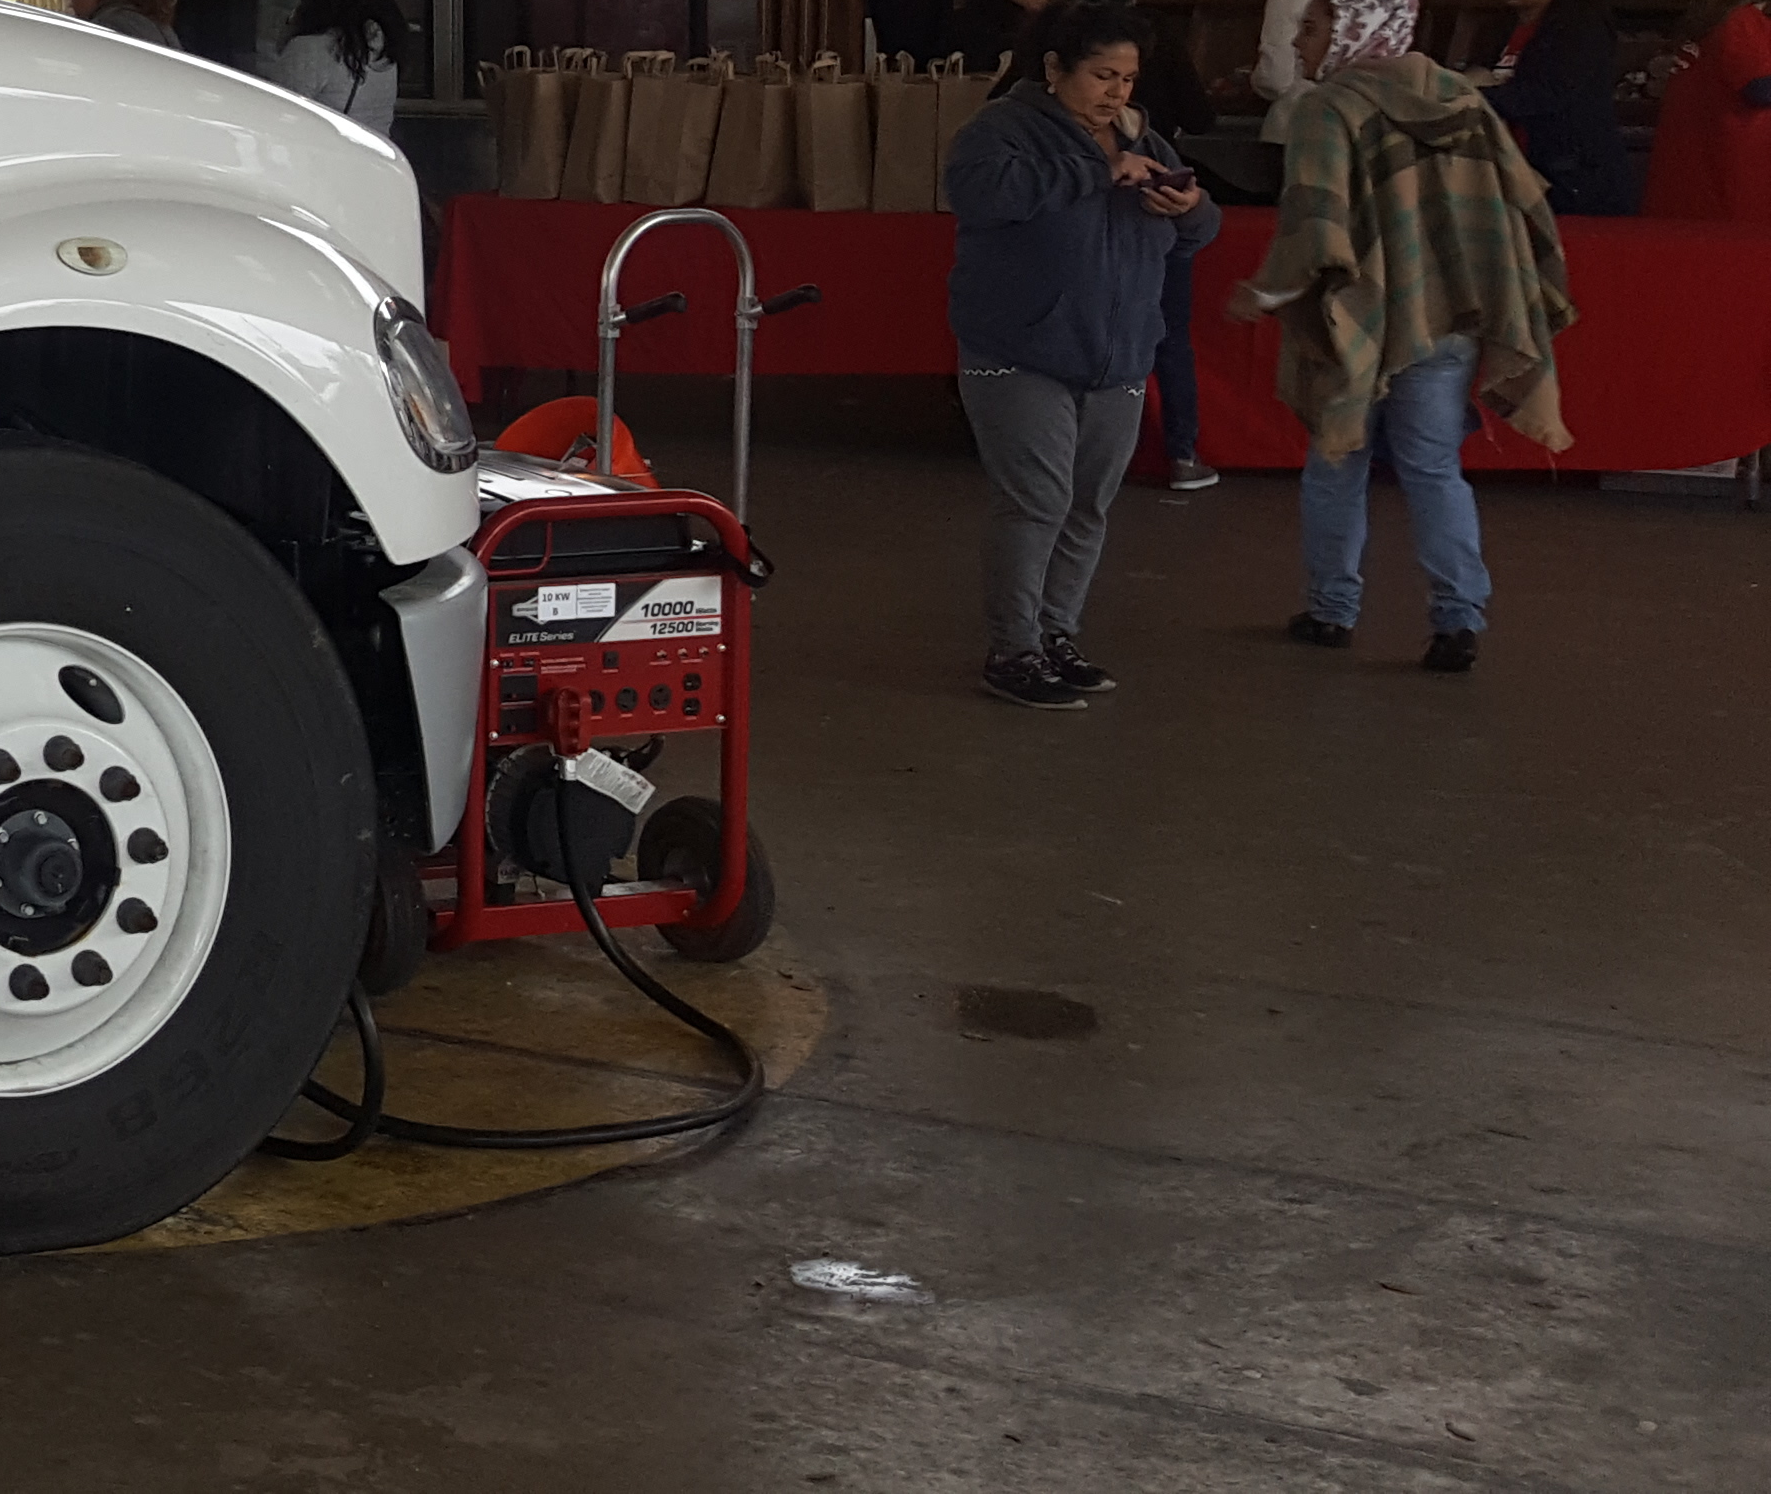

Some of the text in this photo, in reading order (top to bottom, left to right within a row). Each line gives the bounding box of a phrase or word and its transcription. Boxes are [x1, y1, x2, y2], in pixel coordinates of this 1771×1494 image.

[542, 593, 554, 602] 10
[641, 600, 694, 618] 10000
[649, 620, 695, 635] 12500
[509, 630, 575, 644] ELITE Series
